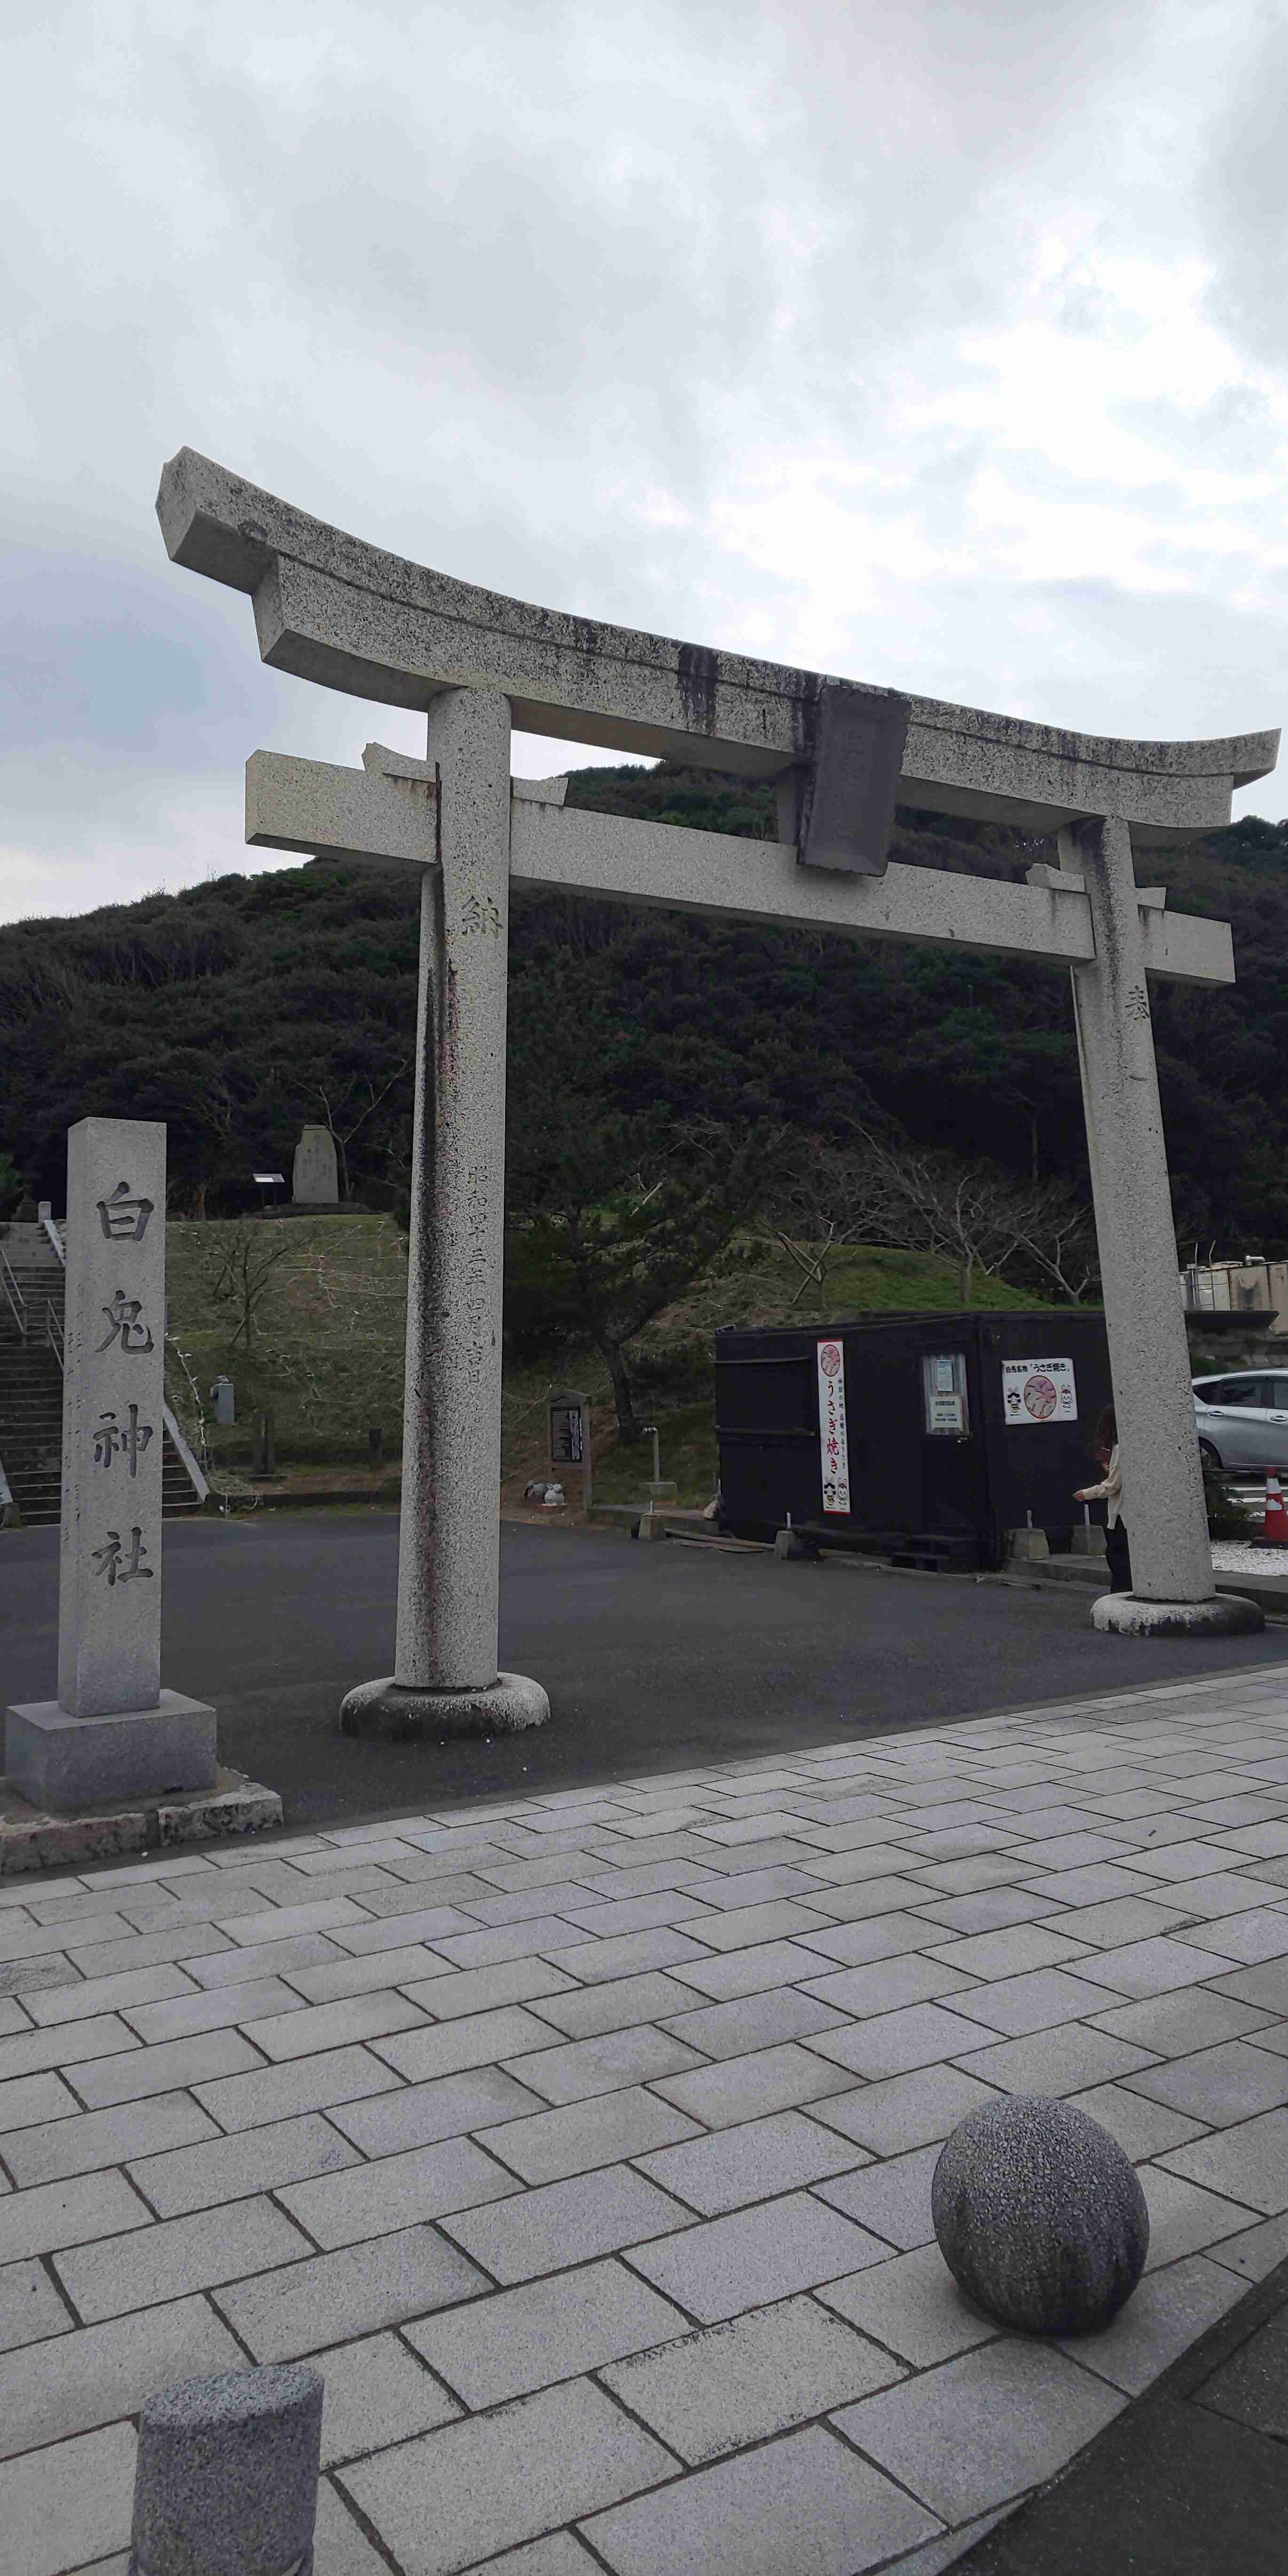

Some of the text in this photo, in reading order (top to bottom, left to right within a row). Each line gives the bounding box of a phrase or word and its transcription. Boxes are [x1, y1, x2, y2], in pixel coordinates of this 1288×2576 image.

[1125, 985, 1150, 1024] 奉
[827, 1381, 840, 1474] うさぎ焼き
